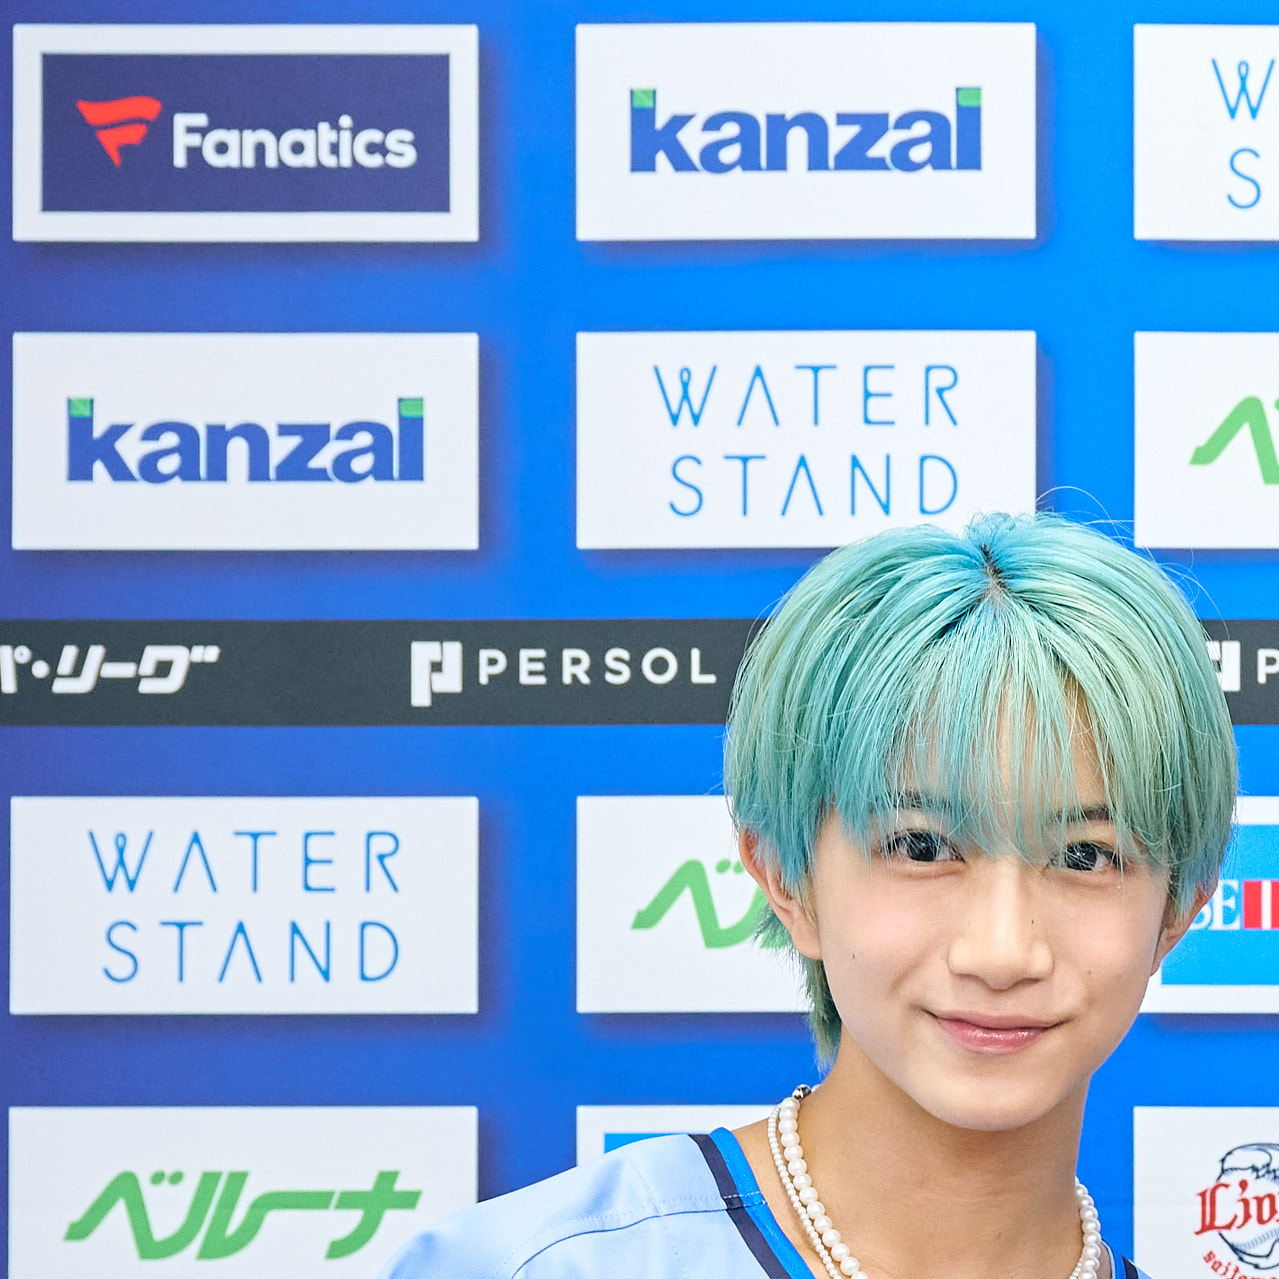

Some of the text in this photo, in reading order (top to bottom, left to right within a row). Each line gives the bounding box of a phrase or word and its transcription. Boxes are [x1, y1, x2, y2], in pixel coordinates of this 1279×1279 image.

[173, 113, 417, 168] Fanatics
[630, 87, 982, 174] kanzai
[654, 365, 957, 426] WATER
[67, 398, 424, 484] kanzai
[670, 455, 957, 516] STAND
[479, 647, 717, 685] PERSOL
[89, 831, 399, 892] WATER
[104, 921, 398, 983] STAND
